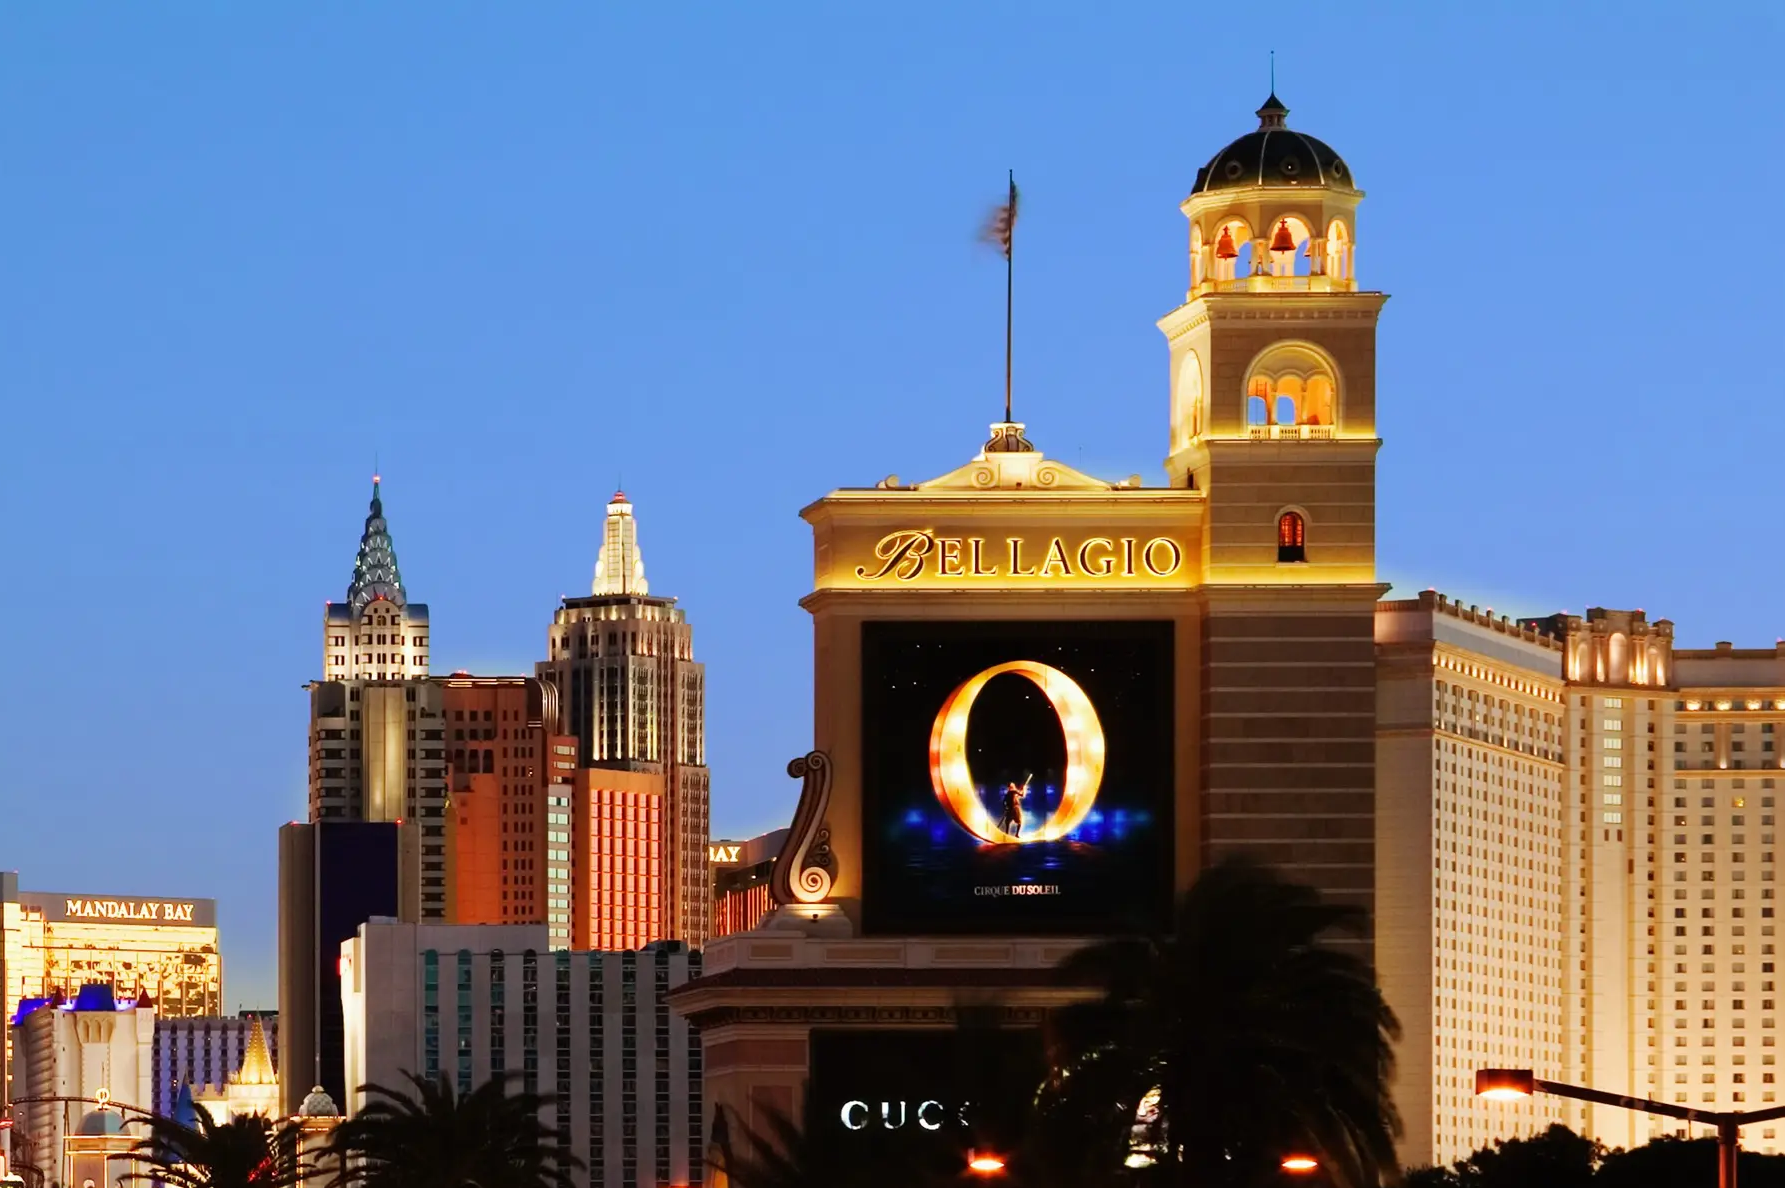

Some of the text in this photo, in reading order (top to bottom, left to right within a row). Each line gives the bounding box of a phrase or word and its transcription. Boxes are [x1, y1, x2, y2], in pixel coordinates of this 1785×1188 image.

[857, 529, 1182, 580] BELLAGIO
[929, 660, 1105, 844] O
[974, 885, 1061, 897] CIRQUE DU SOLEIL
[65, 900, 194, 920] MANDALAY BAY
